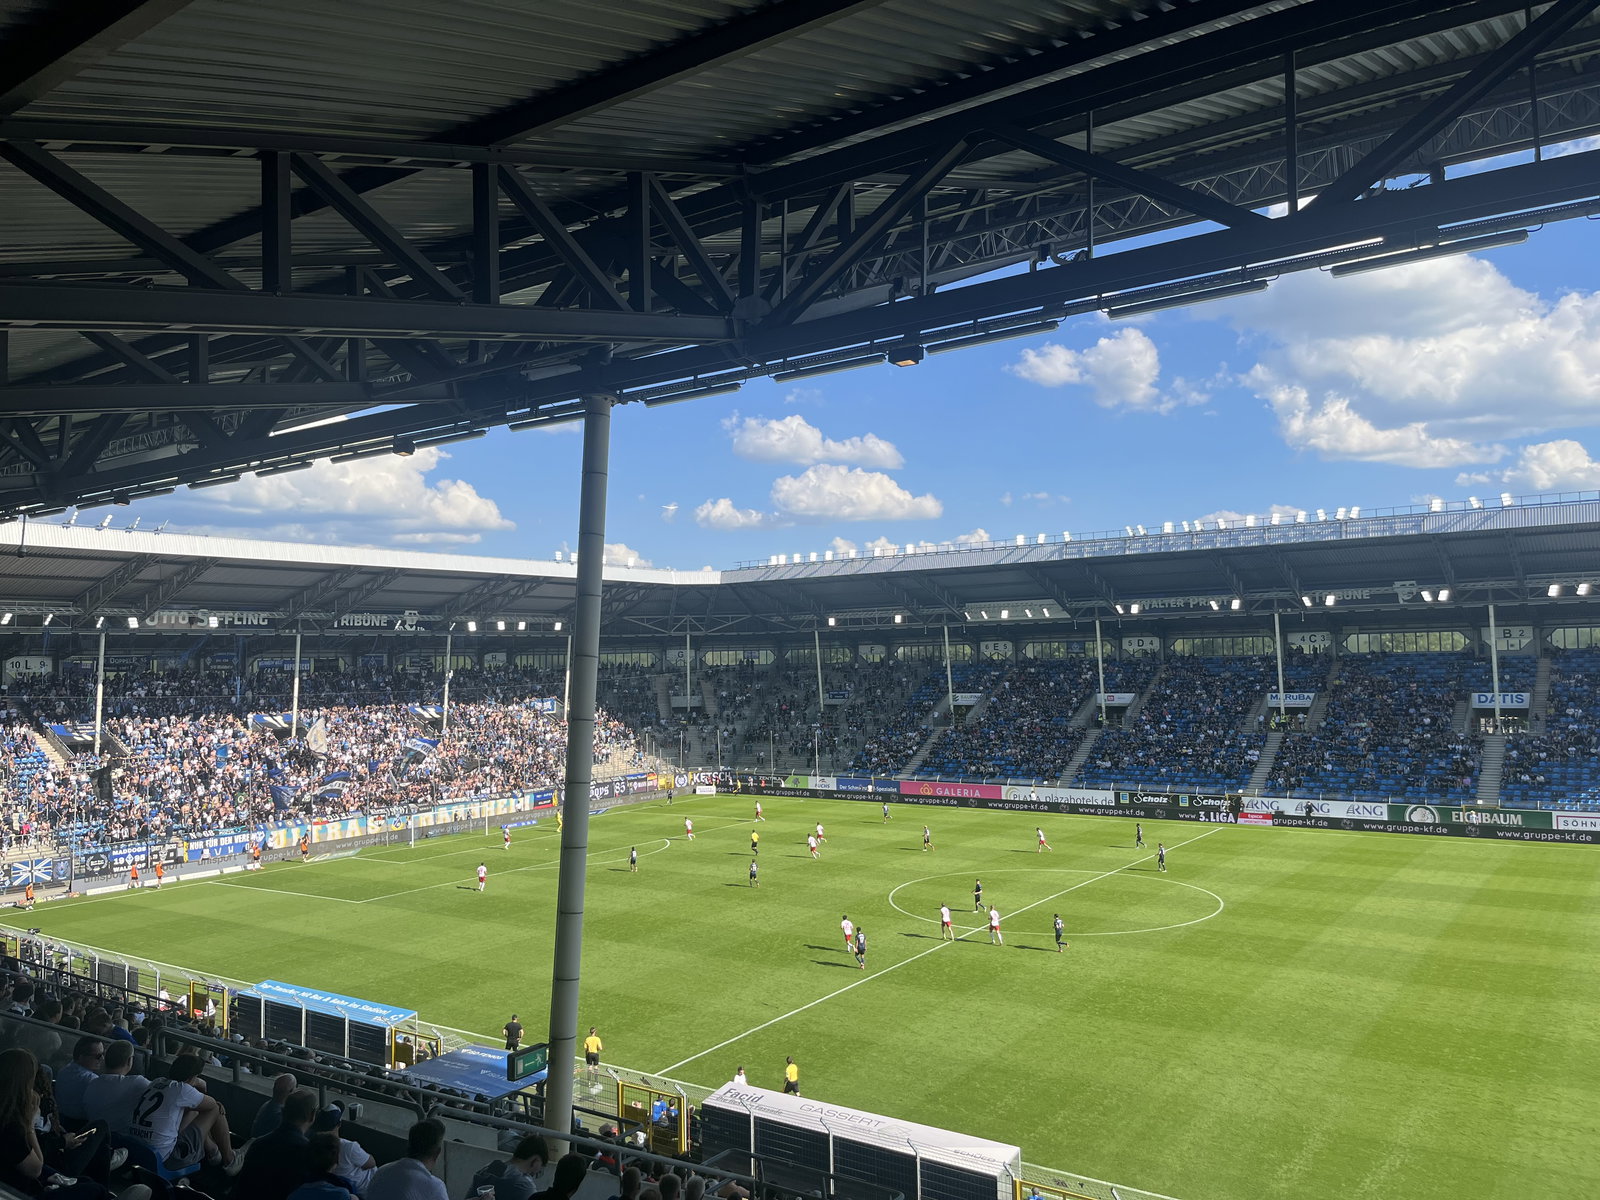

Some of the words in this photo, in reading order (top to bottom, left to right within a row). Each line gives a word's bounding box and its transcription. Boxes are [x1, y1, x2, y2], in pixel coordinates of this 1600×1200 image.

[197, 608, 269, 626] SFFLING
[1309, 634, 1317, 643] C
[1503, 629, 1512, 638] B
[1128, 639, 1133, 647] 5
[1138, 639, 1145, 647] D
[678, 650, 684, 658] G
[10, 661, 20, 669] 10
[25, 660, 31, 670] L
[763, 788, 810, 797] www.gruppe-kf.de
[834, 792, 882, 801] www.gruppe-kf.de
[936, 787, 981, 797] GALERIA
[904, 796, 958, 806] www.gruppe-kf.de
[1045, 793, 1114, 805] plazahotels.de
[1133, 792, 1168, 804] Scholz
[988, 801, 1049, 811] www.gruppe-kf.de
[1079, 806, 1145, 818] www.gruppe-kf.de
[1199, 811, 1209, 822] 3.
[1210, 812, 1236, 824] LIGA
[1363, 822, 1448, 834] www.gruppe-kf.de
[189, 841, 204, 851] NUR
[206, 837, 219, 848] FÜR
[220, 835, 233, 846] DEN
[234, 831, 257, 844] VEREN
[1496, 830, 1592, 842] www.gruppe-kf.de
[112, 846, 147, 856] MADDOGS
[114, 856, 125, 865] 19
[112, 862, 147, 873] WALDOF
[722, 1088, 764, 1104] Facid
[799, 1103, 887, 1128] GASSERT
